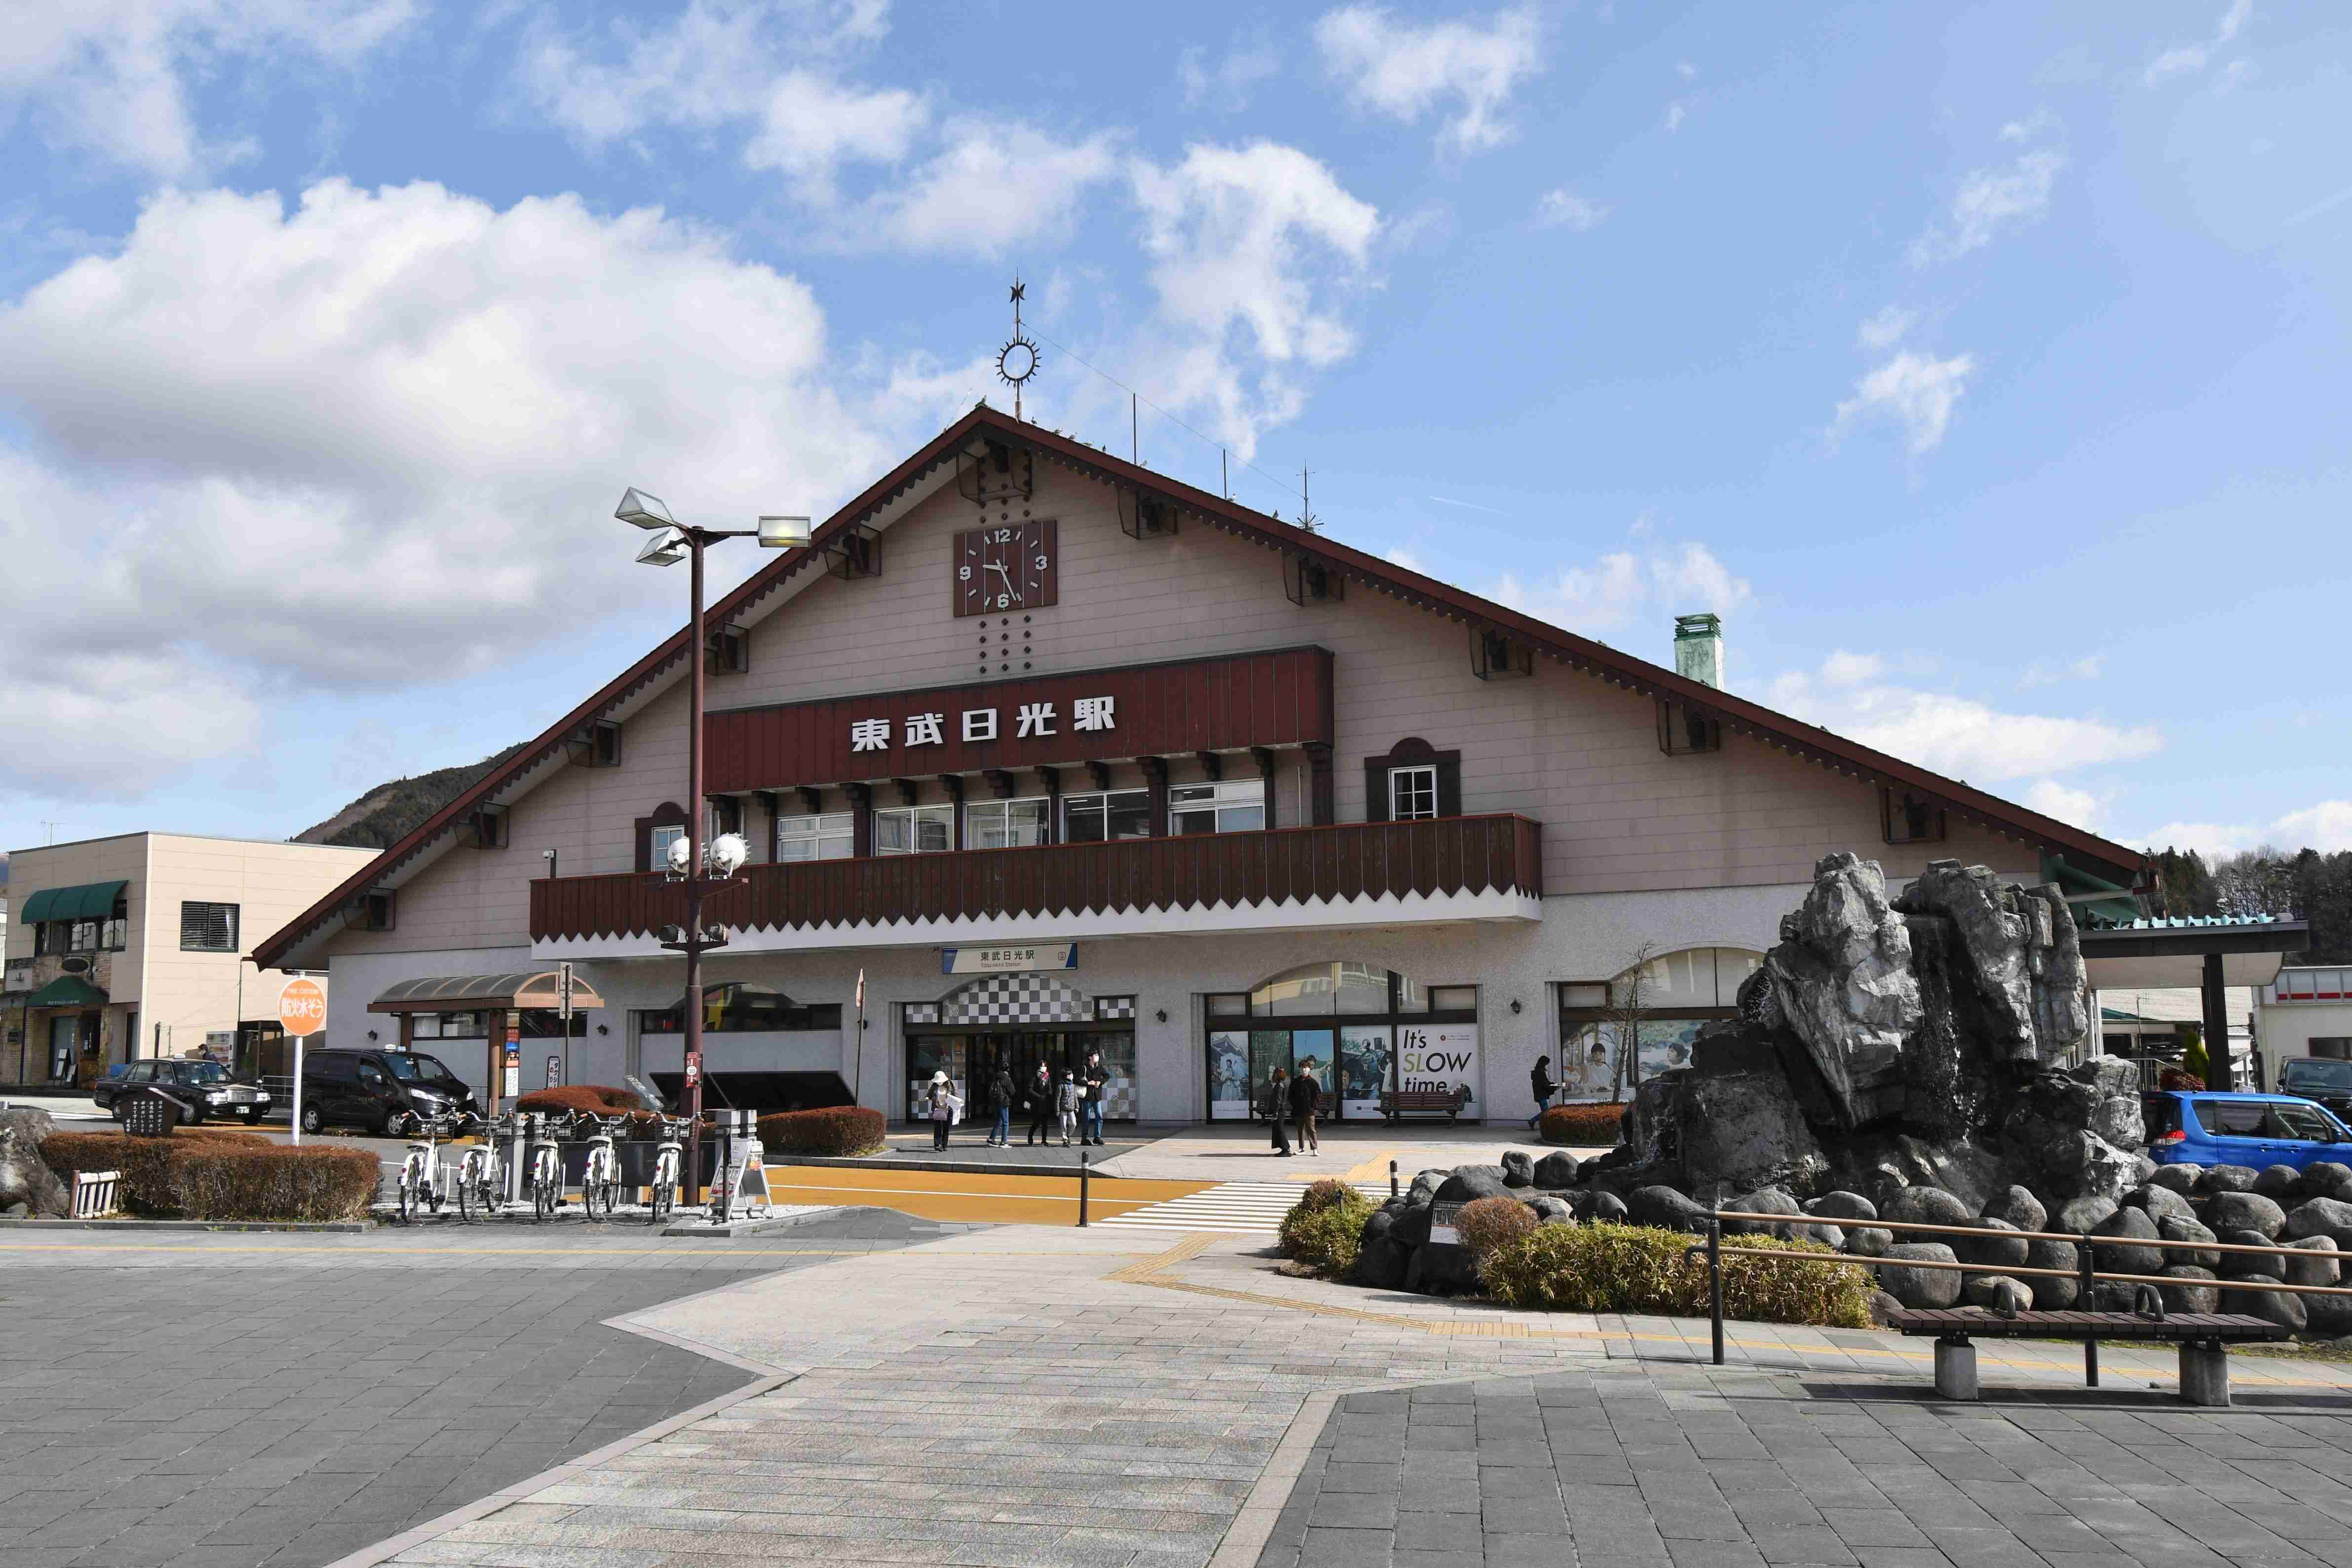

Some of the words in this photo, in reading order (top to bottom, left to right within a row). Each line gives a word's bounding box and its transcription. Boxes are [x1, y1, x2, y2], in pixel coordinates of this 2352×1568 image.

[995, 529, 1011, 543] 12
[1035, 555, 1047, 571] 3
[960, 566, 971, 580] 9
[997, 593, 1009, 609] 6
[851, 695, 1116, 752] 東武日光駅
[980, 950, 1035, 961] 東武日光駅
[1403, 1029, 1427, 1049] It's
[1403, 1052, 1472, 1072] SLOW
